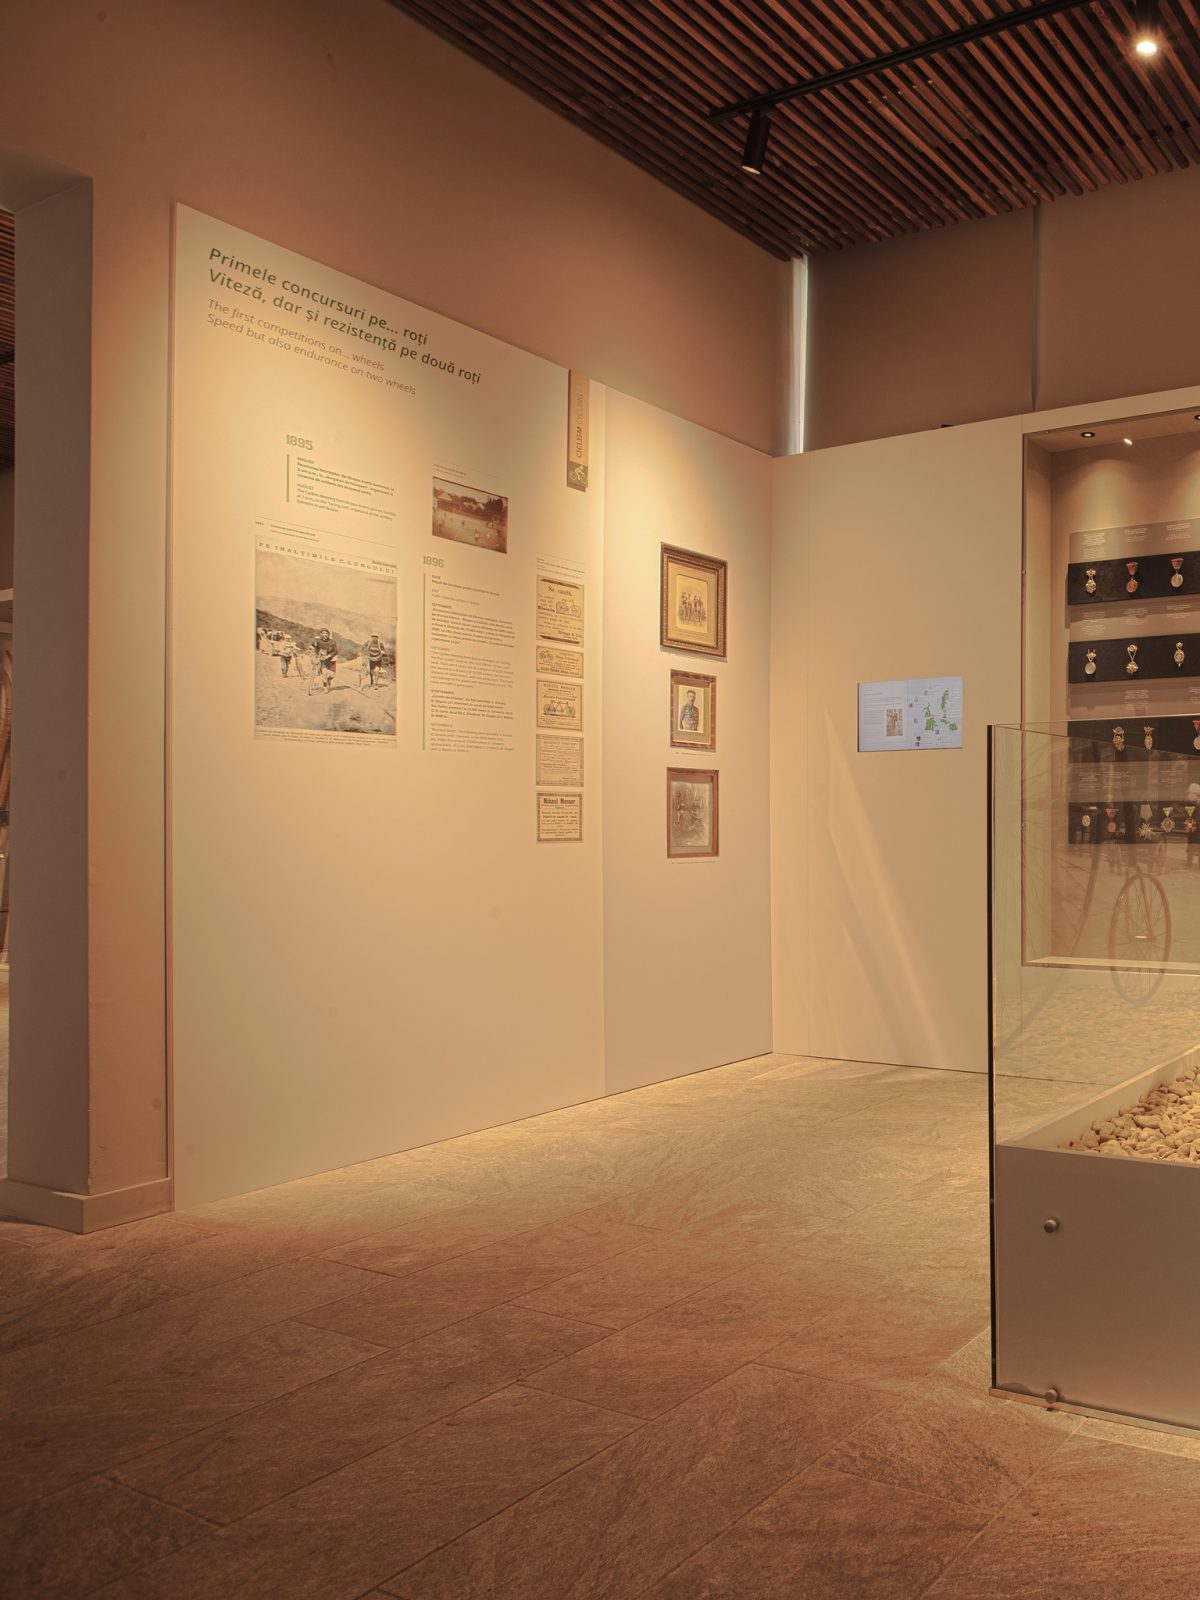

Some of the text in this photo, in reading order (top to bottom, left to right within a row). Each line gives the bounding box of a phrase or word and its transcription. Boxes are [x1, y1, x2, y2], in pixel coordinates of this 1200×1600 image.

[208, 298, 385, 371] The first competitions on... wheels
[209, 248, 428, 346] Primele concursuri pe... roți
[210, 268, 481, 385] Viteză, dar și rezistență pe două roți
[207, 313, 417, 395] Speed but also endurance on two wheels
[286, 434, 313, 450] 1895
[423, 555, 445, 568] 1896
